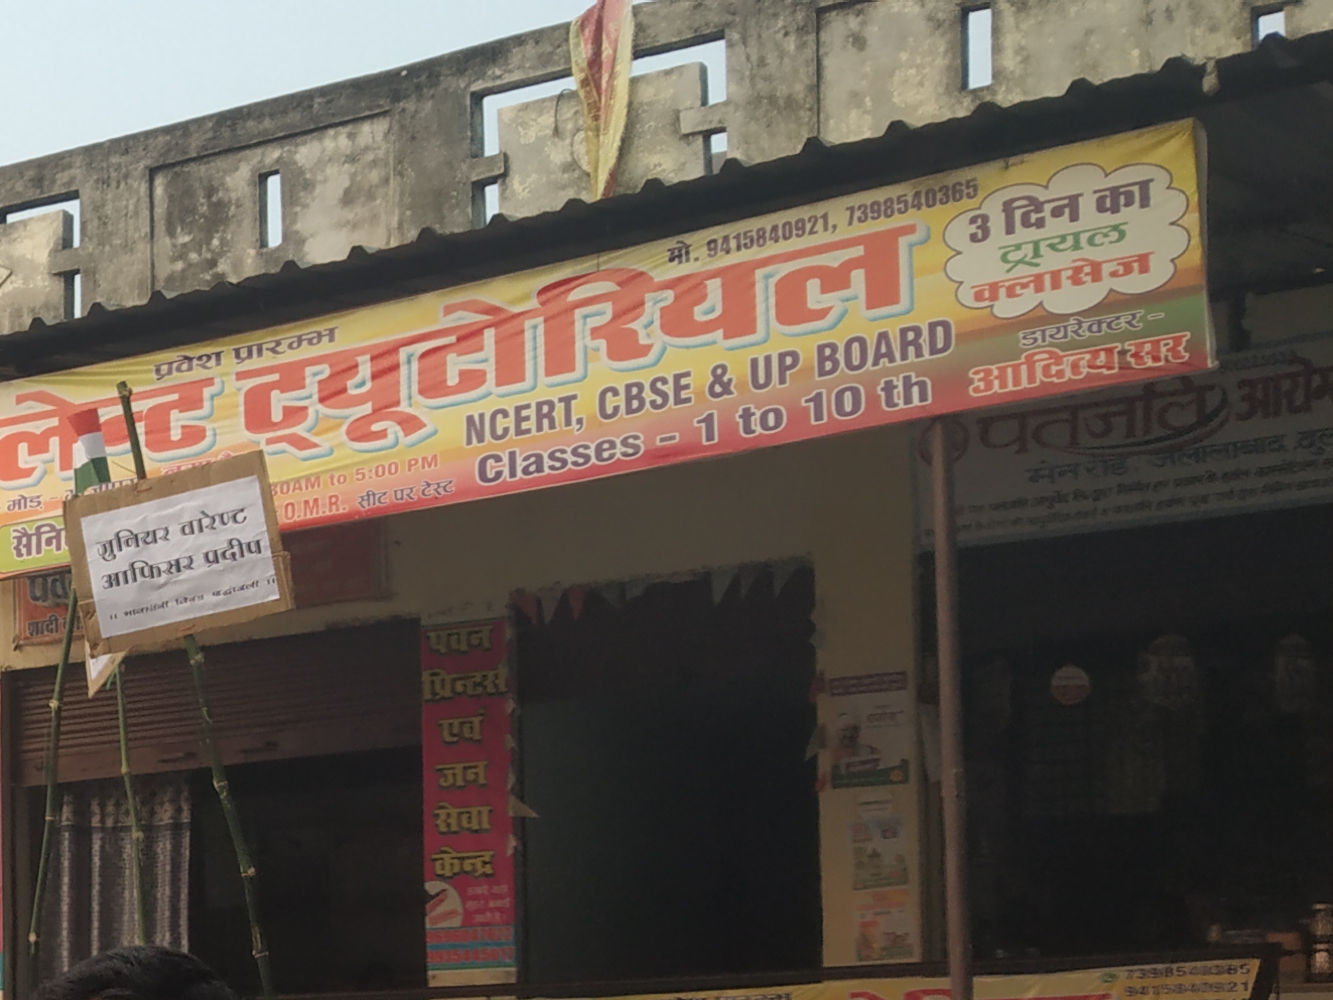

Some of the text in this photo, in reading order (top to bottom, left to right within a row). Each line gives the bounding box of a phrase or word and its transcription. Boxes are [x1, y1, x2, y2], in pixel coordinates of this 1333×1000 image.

[704, 211, 838, 258] 9415840921,
[845, 178, 979, 227] 7398540365
[968, 178, 1155, 244] 3 दिन का
[998, 221, 1130, 274] ट्रायल
[970, 250, 1156, 306] क्लासेज
[153, 325, 339, 381] प्रवेश प्रारम्भ
[235, 222, 923, 456] ट्यूटोरियल
[968, 332, 1191, 398] आदित्य सर
[464, 319, 954, 447] NCERT, CBSE & UP BOARD
[476, 373, 932, 487] Classes 1 to 10 th
[328, 452, 441, 489] to 5:00 PM
[281, 494, 349, 524] O.M.R.
[356, 485, 389, 511] सीट
[393, 483, 417, 503] पर
[101, 537, 264, 591] आफिसर प्रदीप
[436, 760, 489, 789] जन
[434, 802, 493, 834] सेवा
